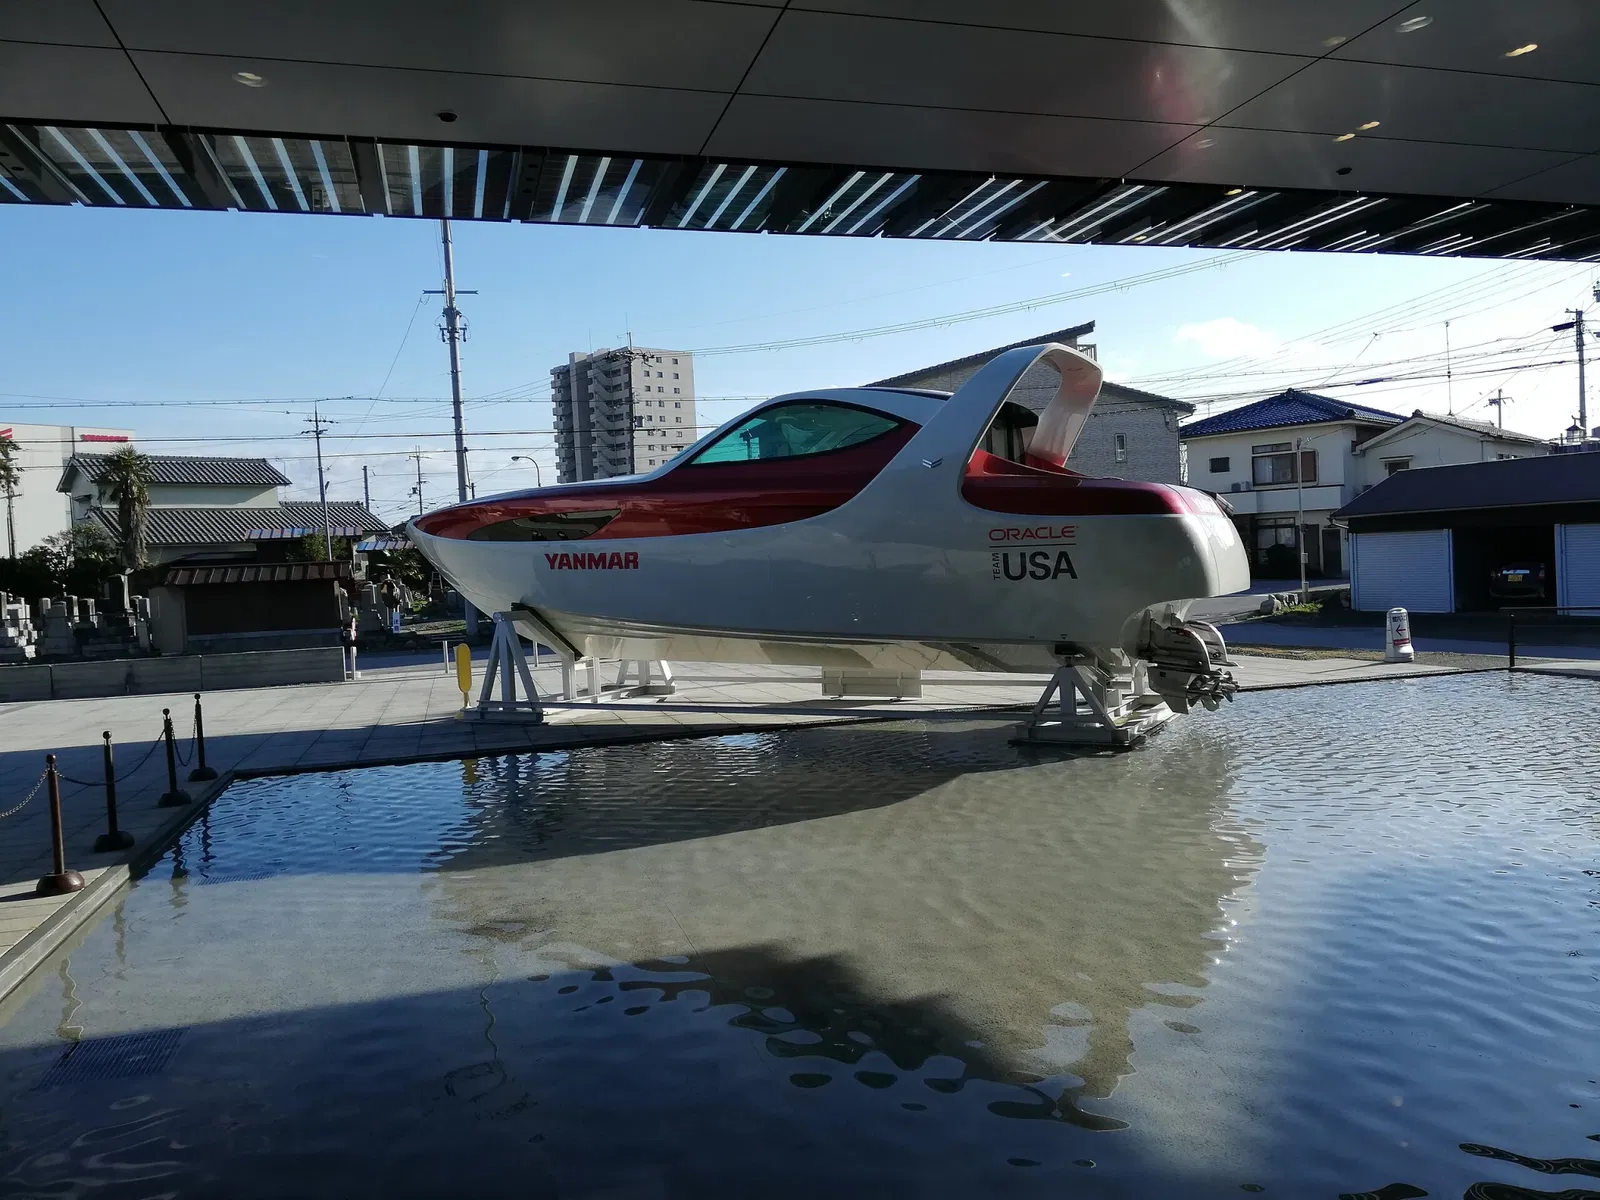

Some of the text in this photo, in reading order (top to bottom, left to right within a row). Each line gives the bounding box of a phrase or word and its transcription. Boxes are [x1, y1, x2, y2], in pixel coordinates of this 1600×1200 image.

[989, 525, 1076, 541] ORACLE
[544, 551, 639, 570] YANMAR
[992, 552, 1001, 580] TEAM
[1002, 551, 1078, 581] USA
